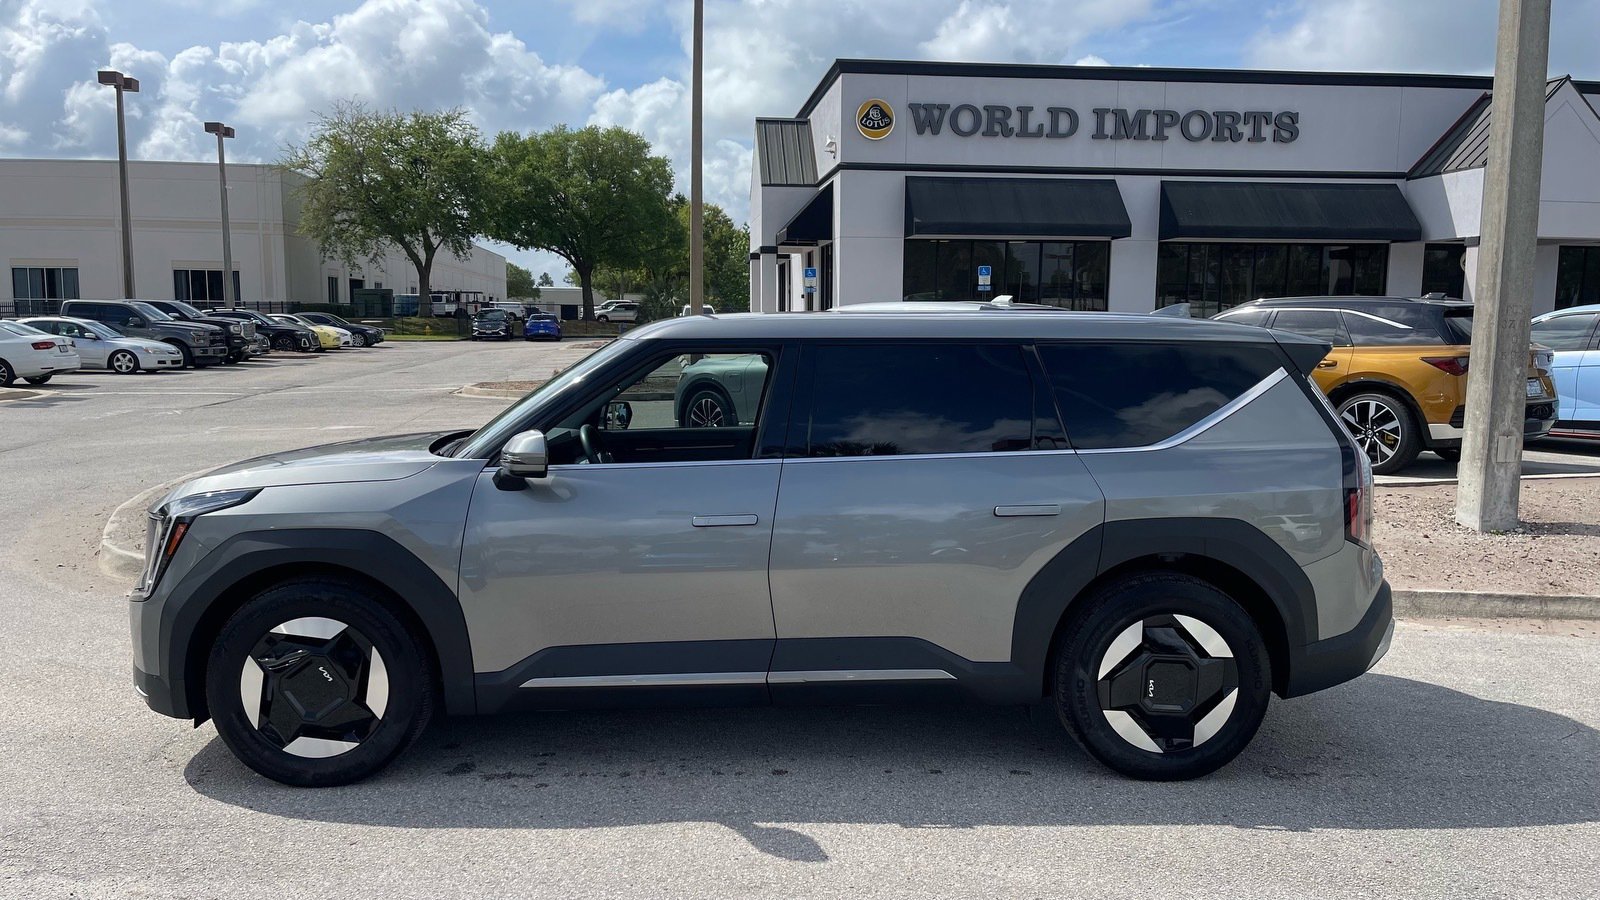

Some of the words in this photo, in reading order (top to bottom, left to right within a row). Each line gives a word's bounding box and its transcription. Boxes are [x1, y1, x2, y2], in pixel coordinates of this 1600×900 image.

[861, 117, 890, 128] LOTUS
[908, 103, 1080, 138] WORLD
[1092, 108, 1300, 143] IMPORTS
